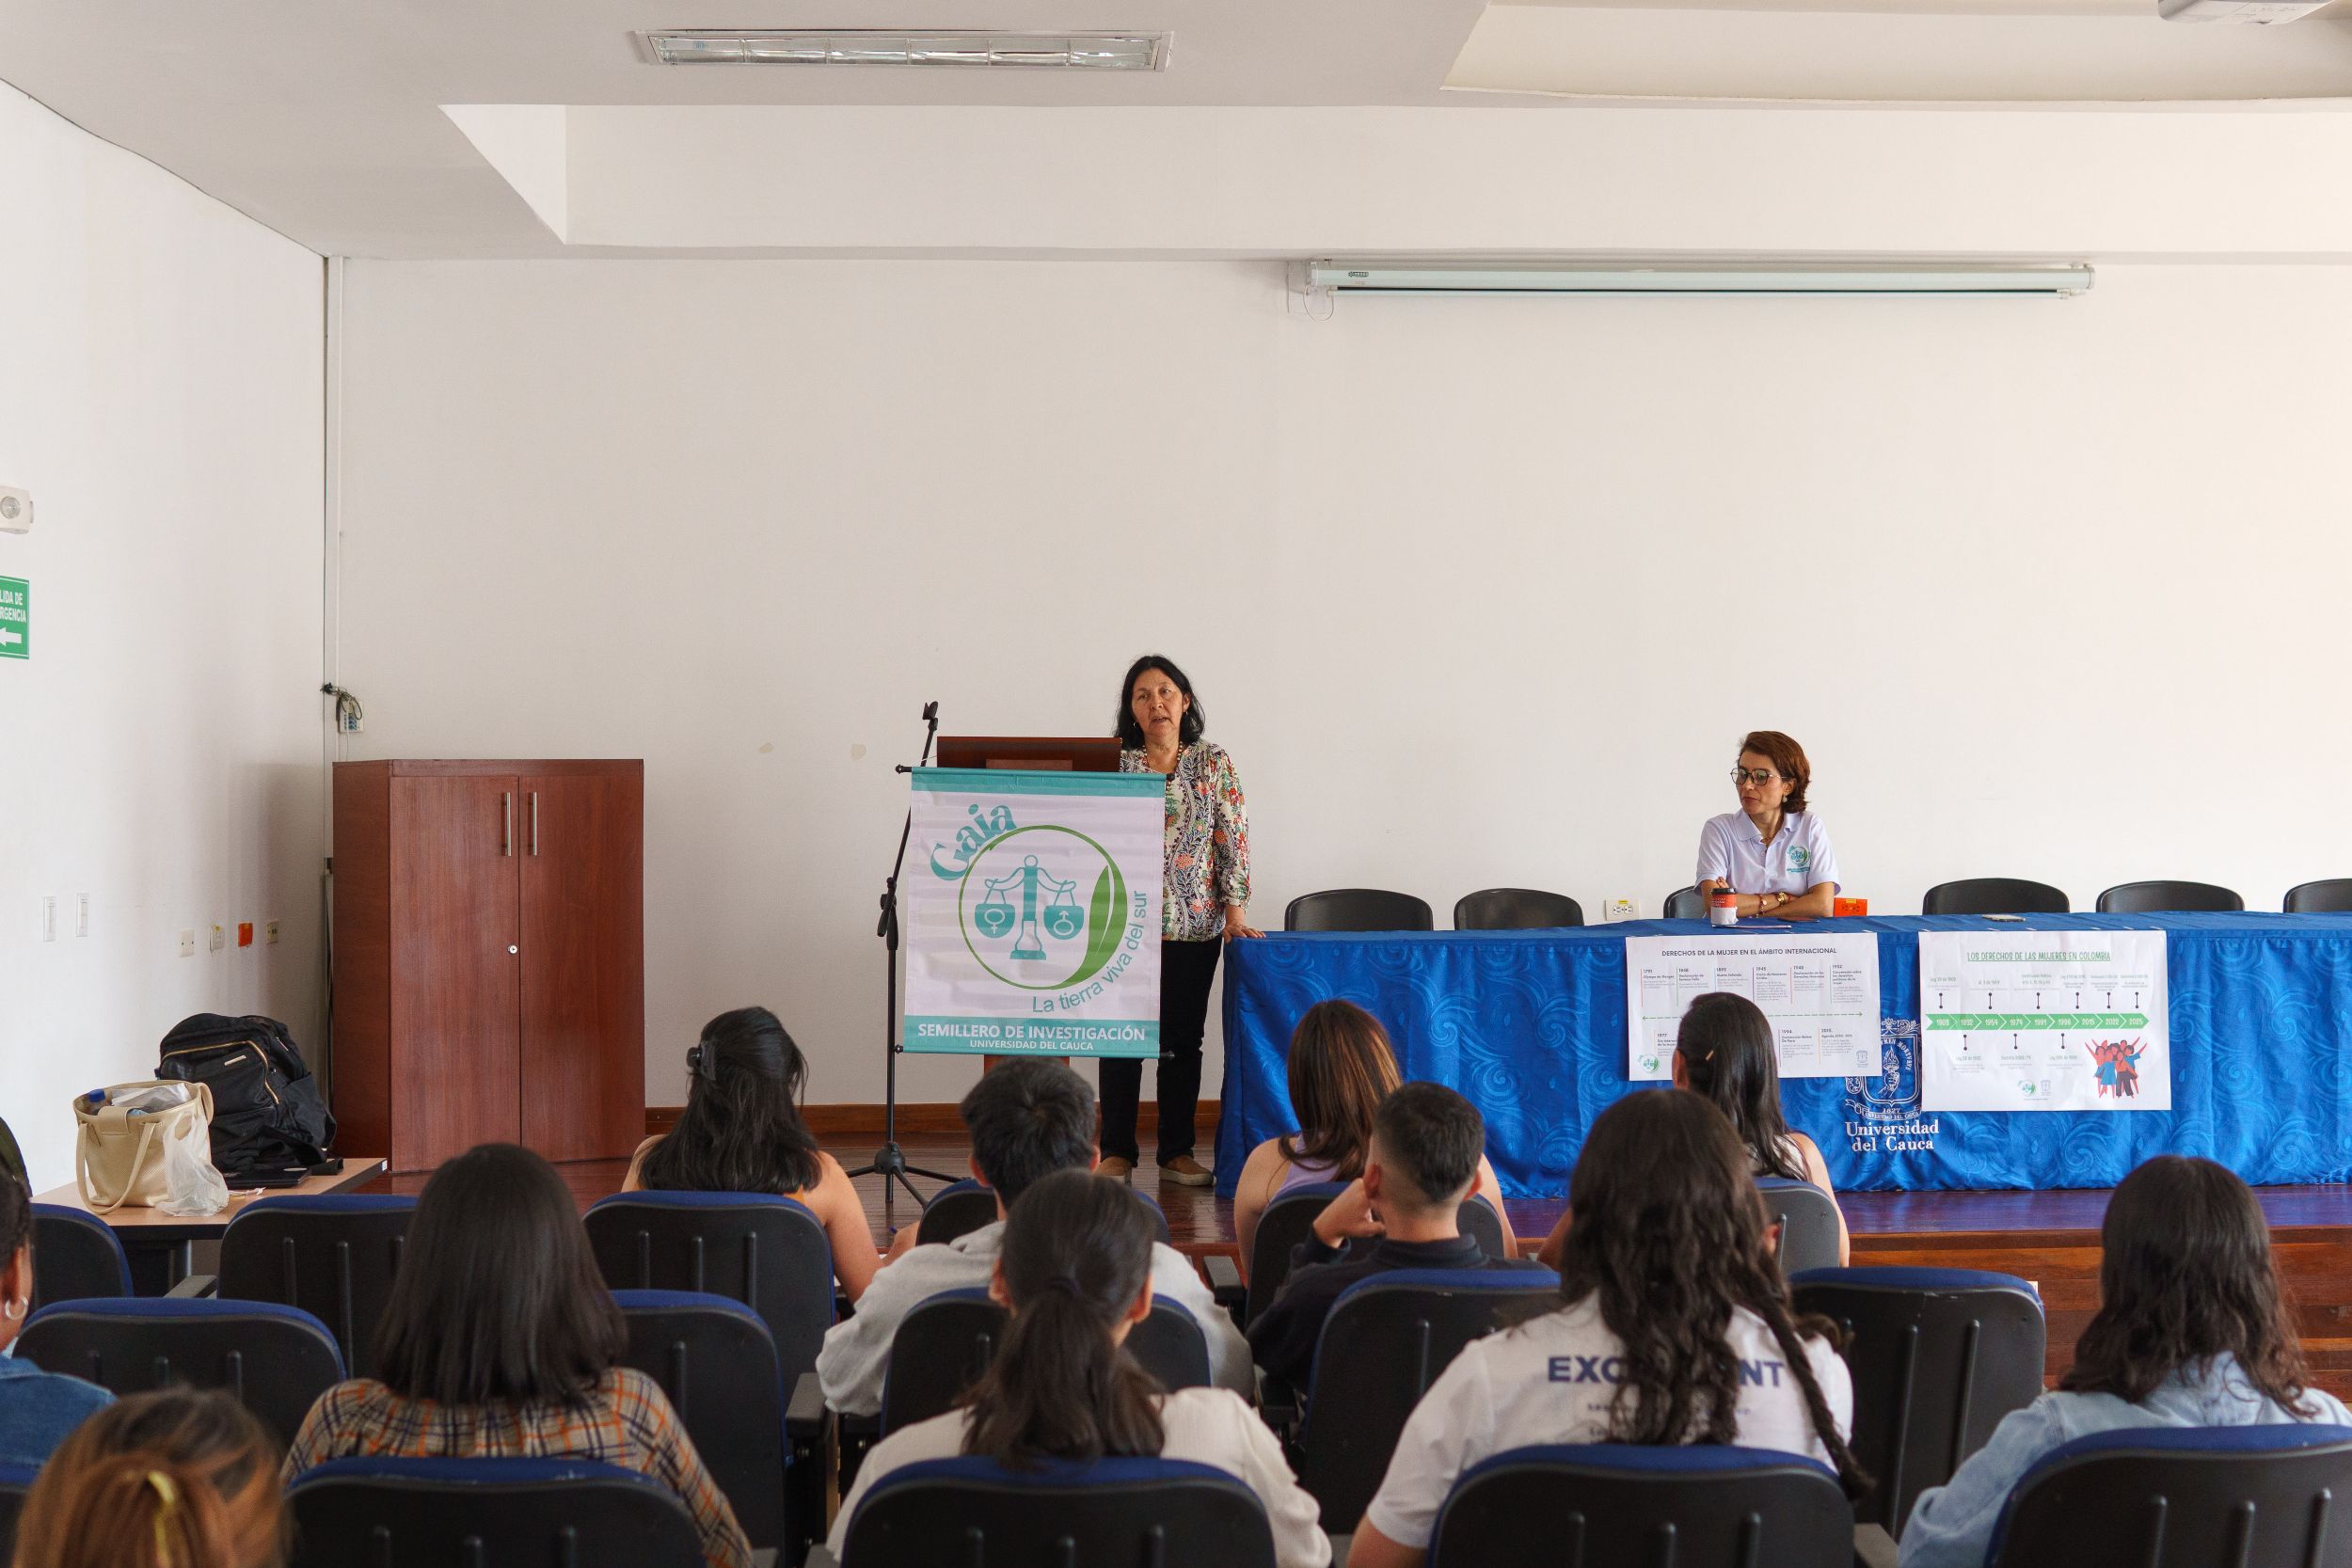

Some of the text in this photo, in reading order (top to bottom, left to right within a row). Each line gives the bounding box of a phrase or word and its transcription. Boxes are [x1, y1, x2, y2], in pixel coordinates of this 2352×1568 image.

[15, 592, 23, 606] DE
[930, 803, 1017, 880] Gaia
[1033, 891, 1147, 1013] La tierra viva del sur
[1967, 951, 2111, 960] LOS DERECHOS DE LAS MUJERES EN COLOMBIA
[918, 1023, 1145, 1040] SEMILLERO DE INVESTIGACIÓN
[970, 1039, 1093, 1051] UNIVERSIDAD DEL CAUCA
[1845, 1119, 1939, 1136] Universidad
[1851, 1136, 1934, 1152] del Cauca
[1548, 1355, 1785, 1387] EXCNT
